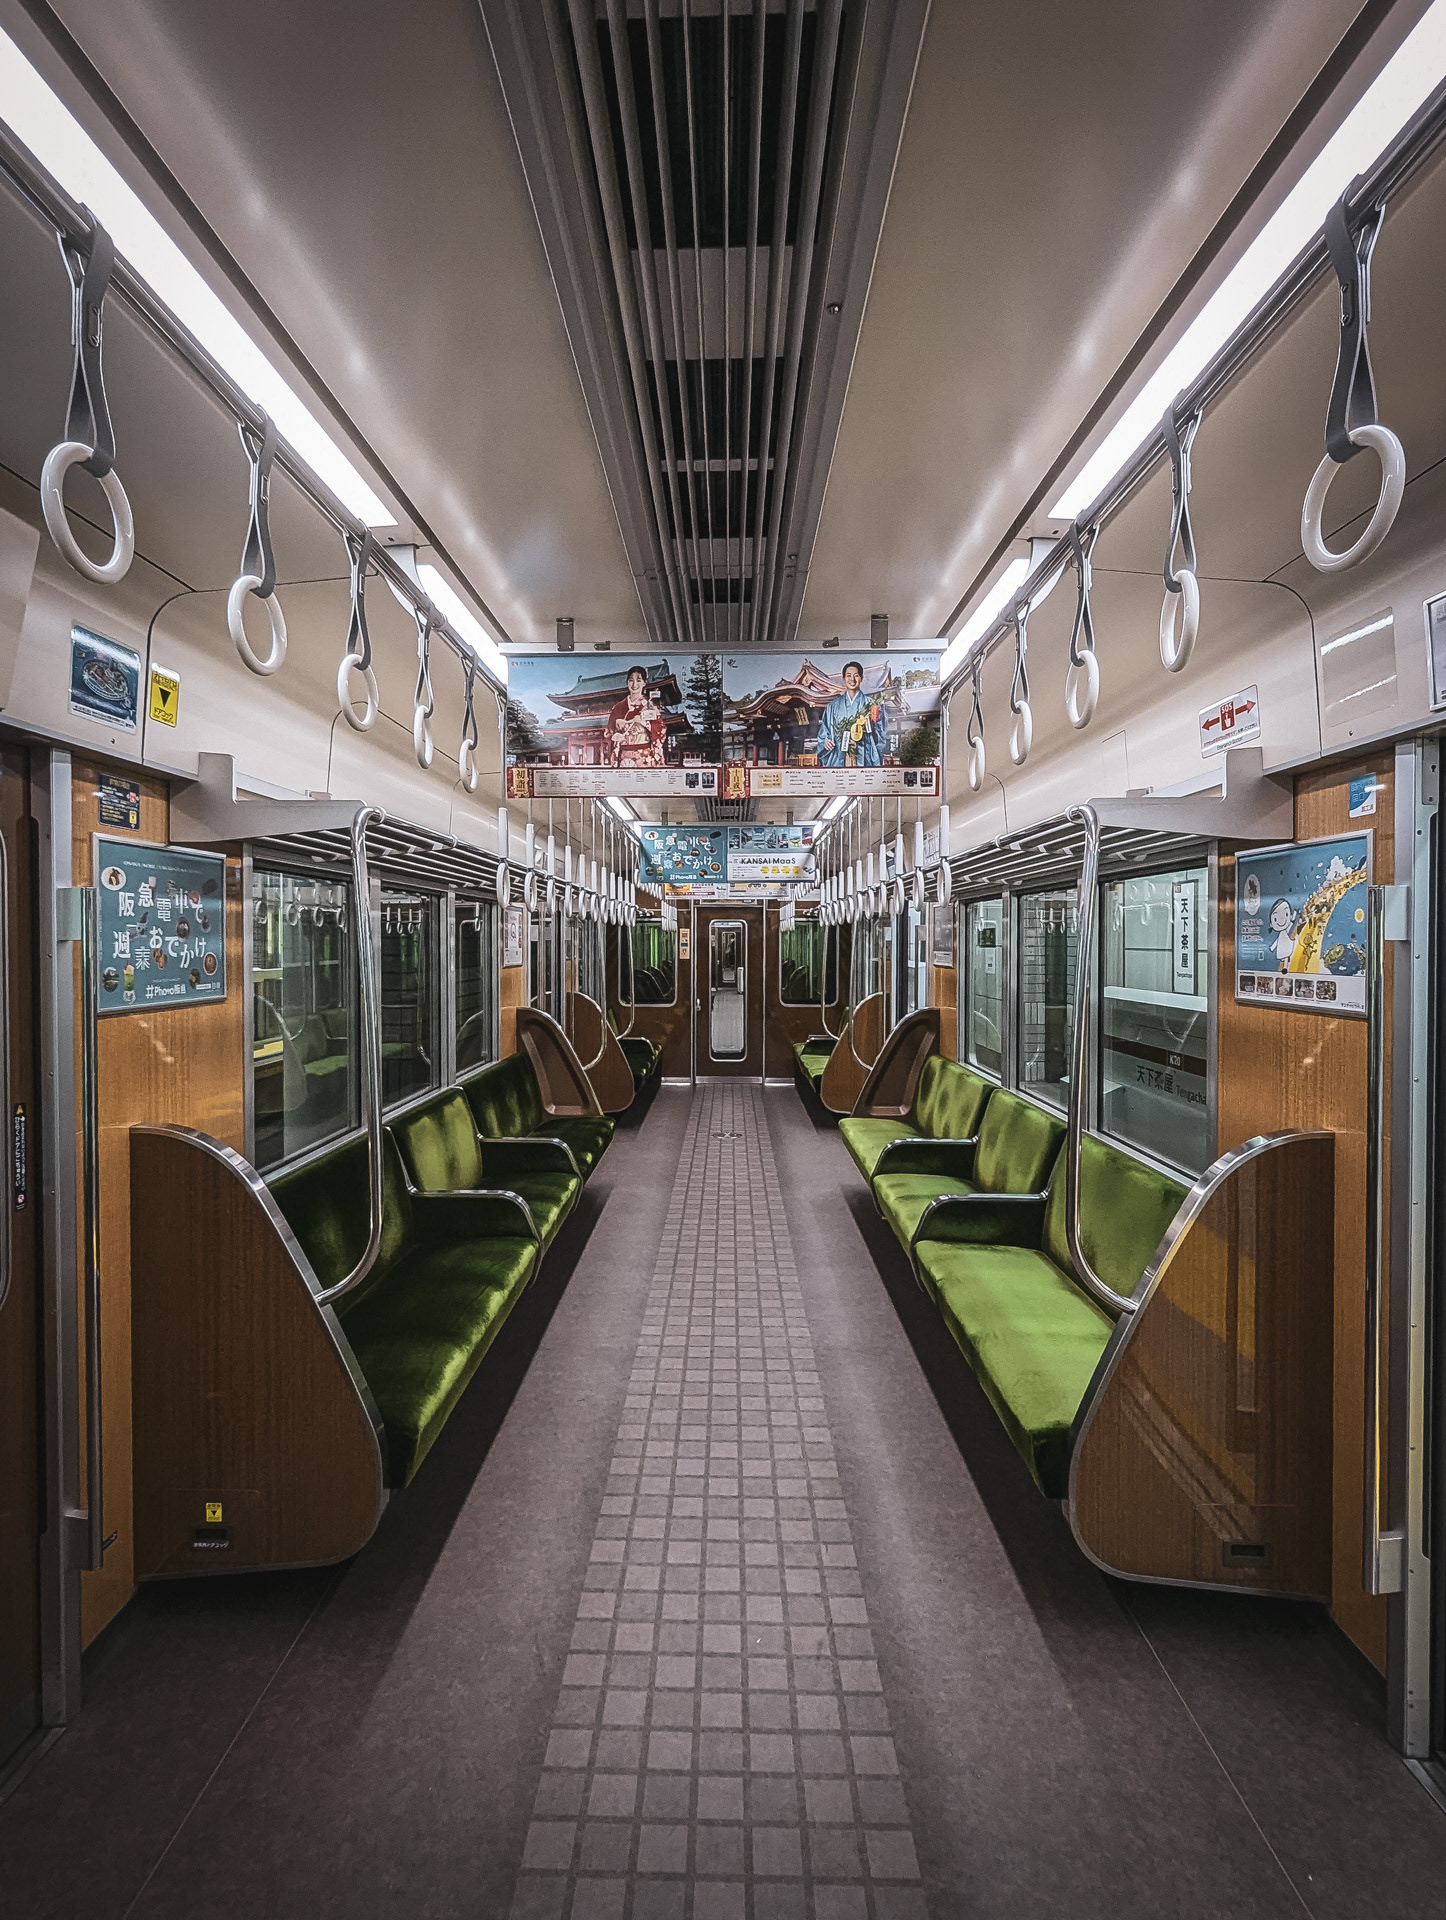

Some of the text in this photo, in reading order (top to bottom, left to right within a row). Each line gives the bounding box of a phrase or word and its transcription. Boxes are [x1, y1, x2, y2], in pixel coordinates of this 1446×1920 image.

[1221, 702, 1233, 714] SOS
[741, 857, 796, 865] KANSAI MaaS
[1180, 898, 1189, 968] 天下茶屋
[1136, 1064, 1174, 1095] 天下茶屋
